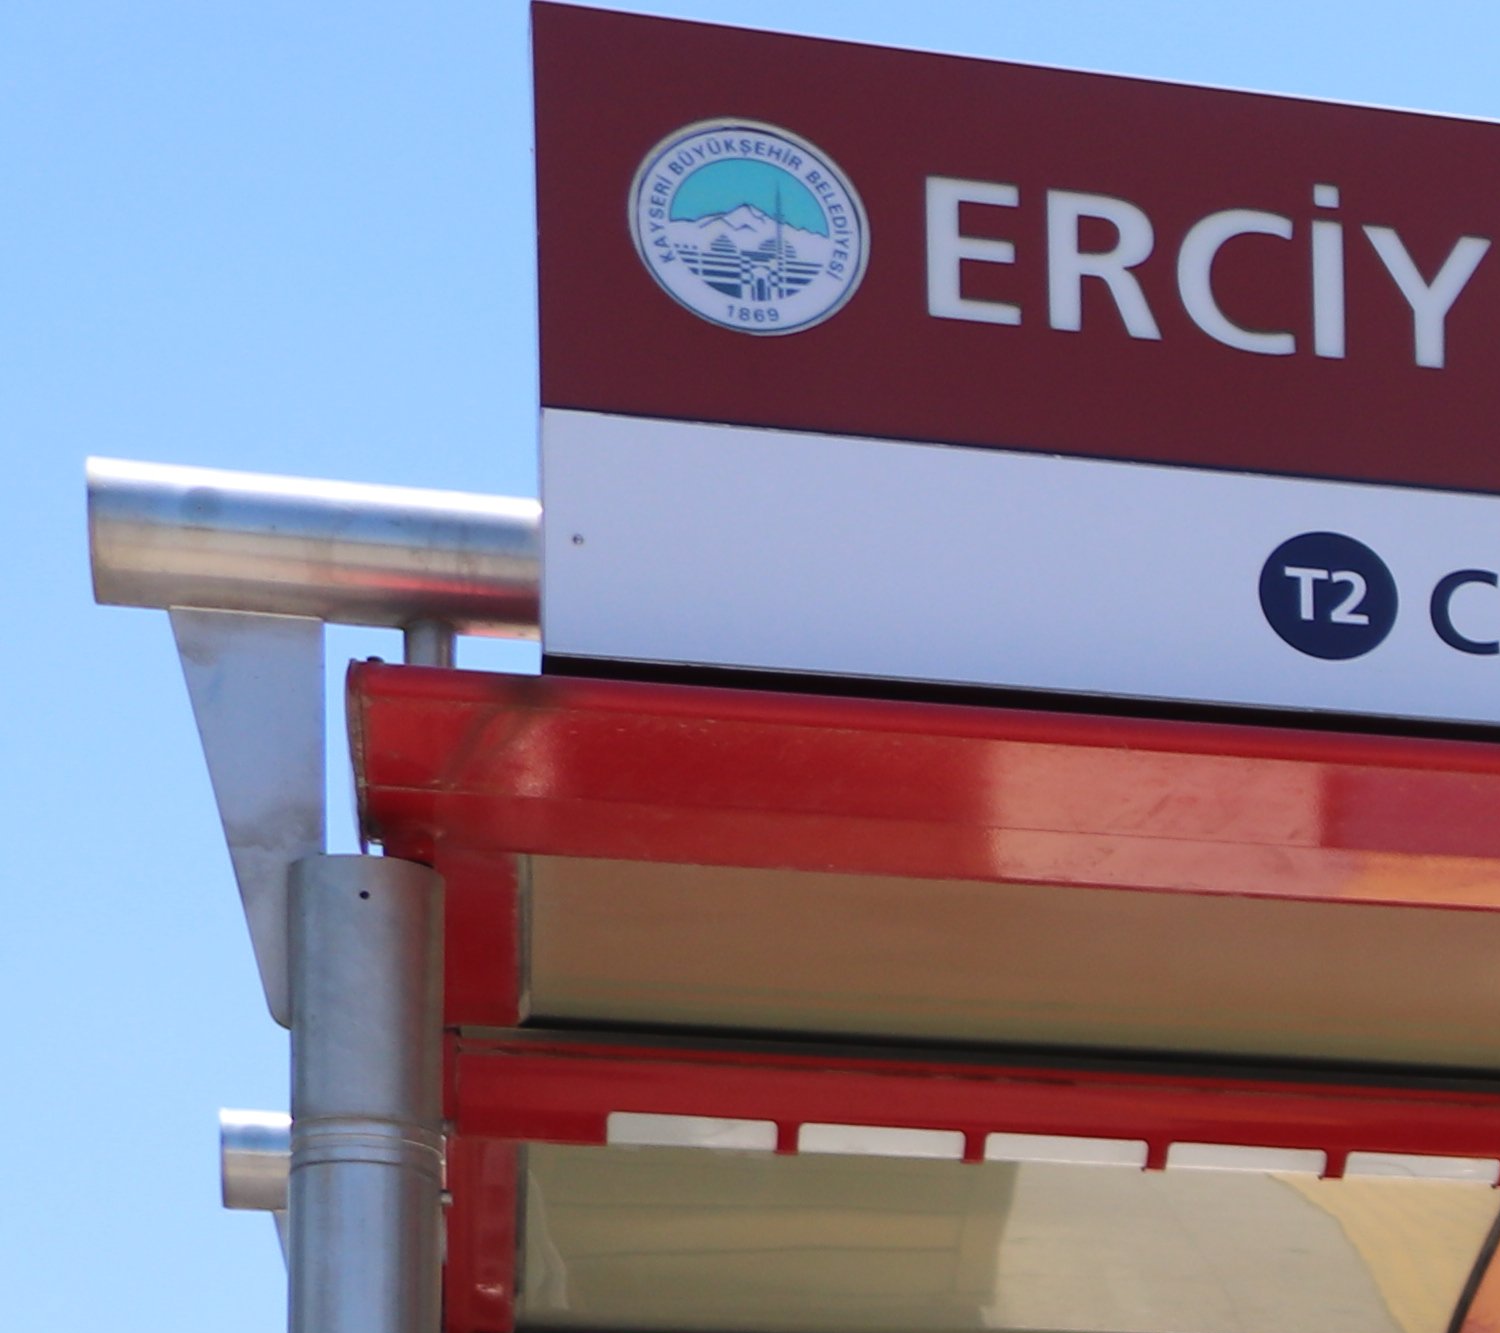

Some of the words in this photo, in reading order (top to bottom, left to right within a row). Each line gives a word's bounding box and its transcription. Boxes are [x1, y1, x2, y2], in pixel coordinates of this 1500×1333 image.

[649, 175, 675, 263] KAYSERİ
[668, 137, 803, 176] BÜYÜKŞEHİR
[806, 170, 854, 282] BELEDİYESİ
[727, 305, 780, 323] 1869
[1284, 566, 1371, 627] T2
